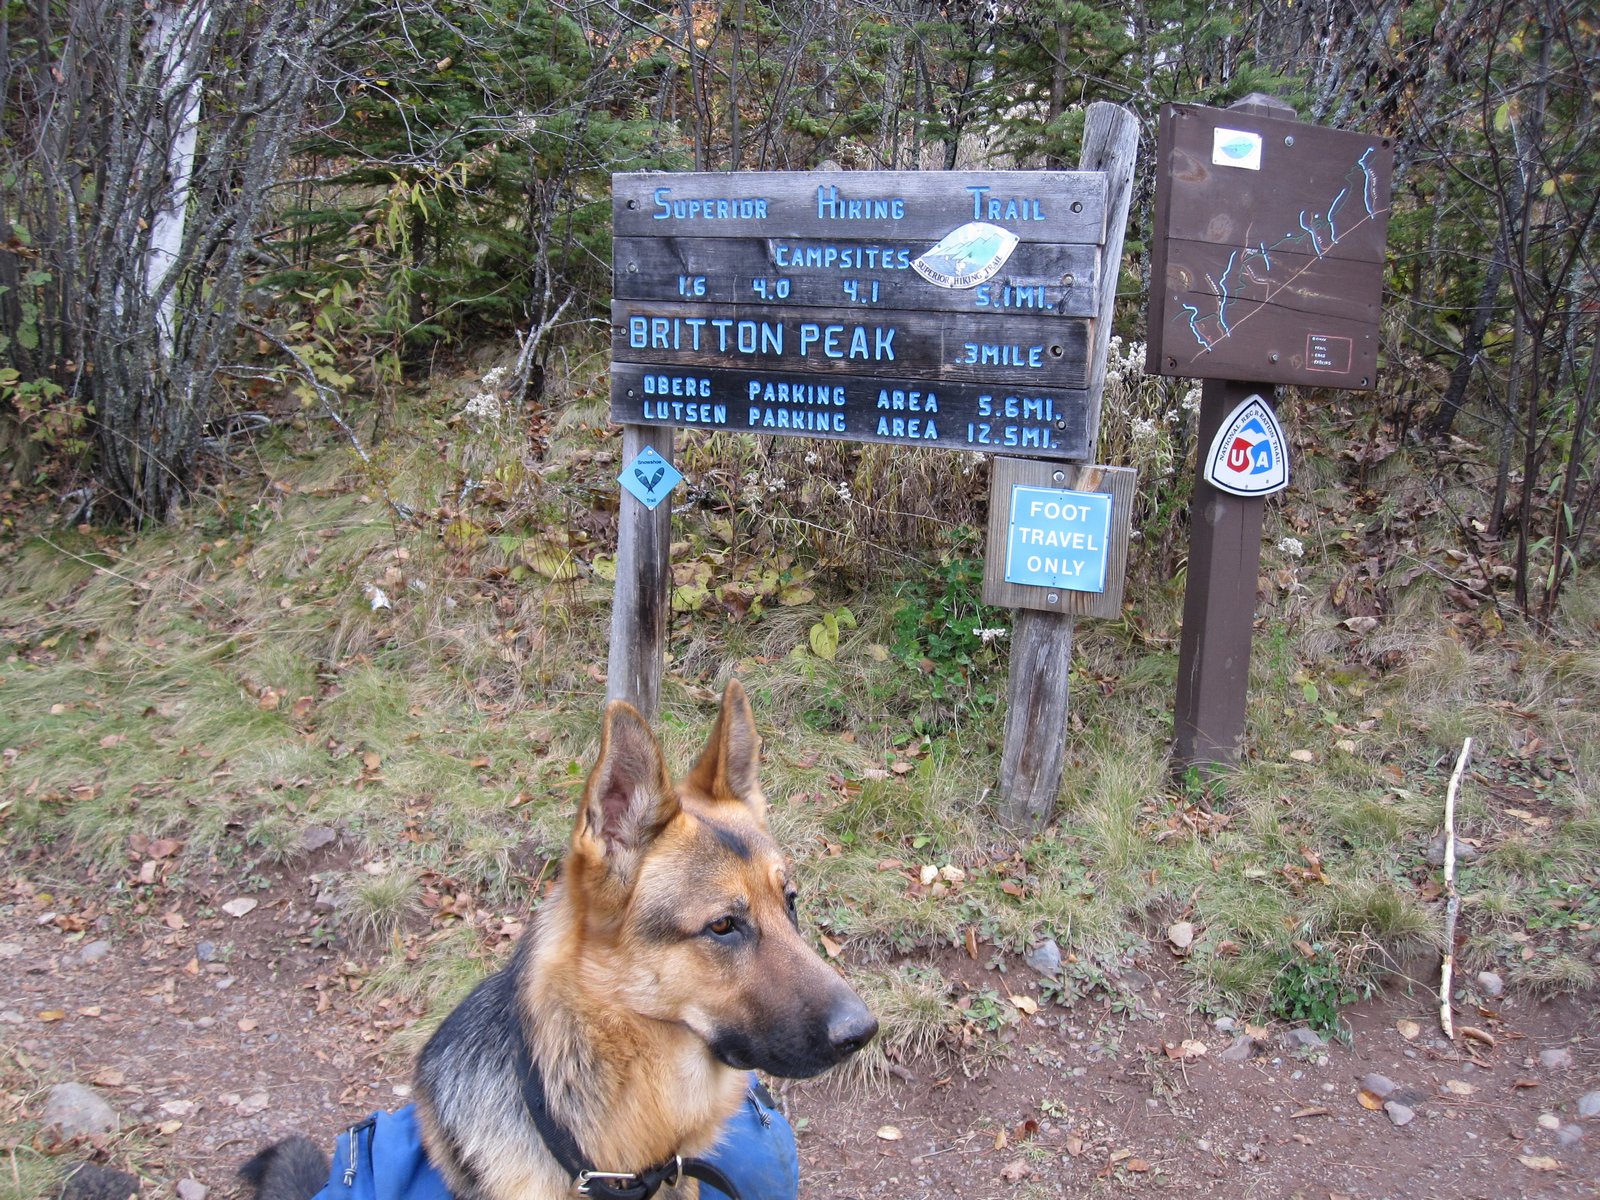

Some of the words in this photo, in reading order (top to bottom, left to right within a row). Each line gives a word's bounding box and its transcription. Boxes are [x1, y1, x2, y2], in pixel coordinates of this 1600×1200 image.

[653, 187, 768, 220] SUPERIOR
[817, 184, 905, 220] HIKING
[966, 185, 1046, 220] TRAIL
[776, 245, 911, 269] CAMPSITES
[917, 260, 950, 284] SUPERIOR
[953, 273, 982, 285] HIKING
[984, 255, 1003, 275] TRAIL
[679, 275, 706, 297] 1.6
[752, 278, 791, 300] 4.0
[842, 278, 880, 304] 4.1
[629, 316, 783, 355] BRITTON
[801, 323, 896, 361] PEAK
[643, 375, 711, 397] OBERG
[749, 381, 846, 406] PARKING
[877, 389, 938, 413] AREA
[643, 401, 727, 424] LUTSEN
[749, 406, 846, 432] PARKING
[877, 416, 938, 440] AREA
[1219, 424, 1241, 462] NATIONAL
[1241, 409, 1275, 439] RECREATION
[1272, 440, 1281, 466] TRAIL
[1230, 444, 1271, 473] USA
[1030, 501, 1091, 522] FOOT
[1019, 527, 1098, 551] TRAVEL
[1027, 555, 1085, 577] ONLY
